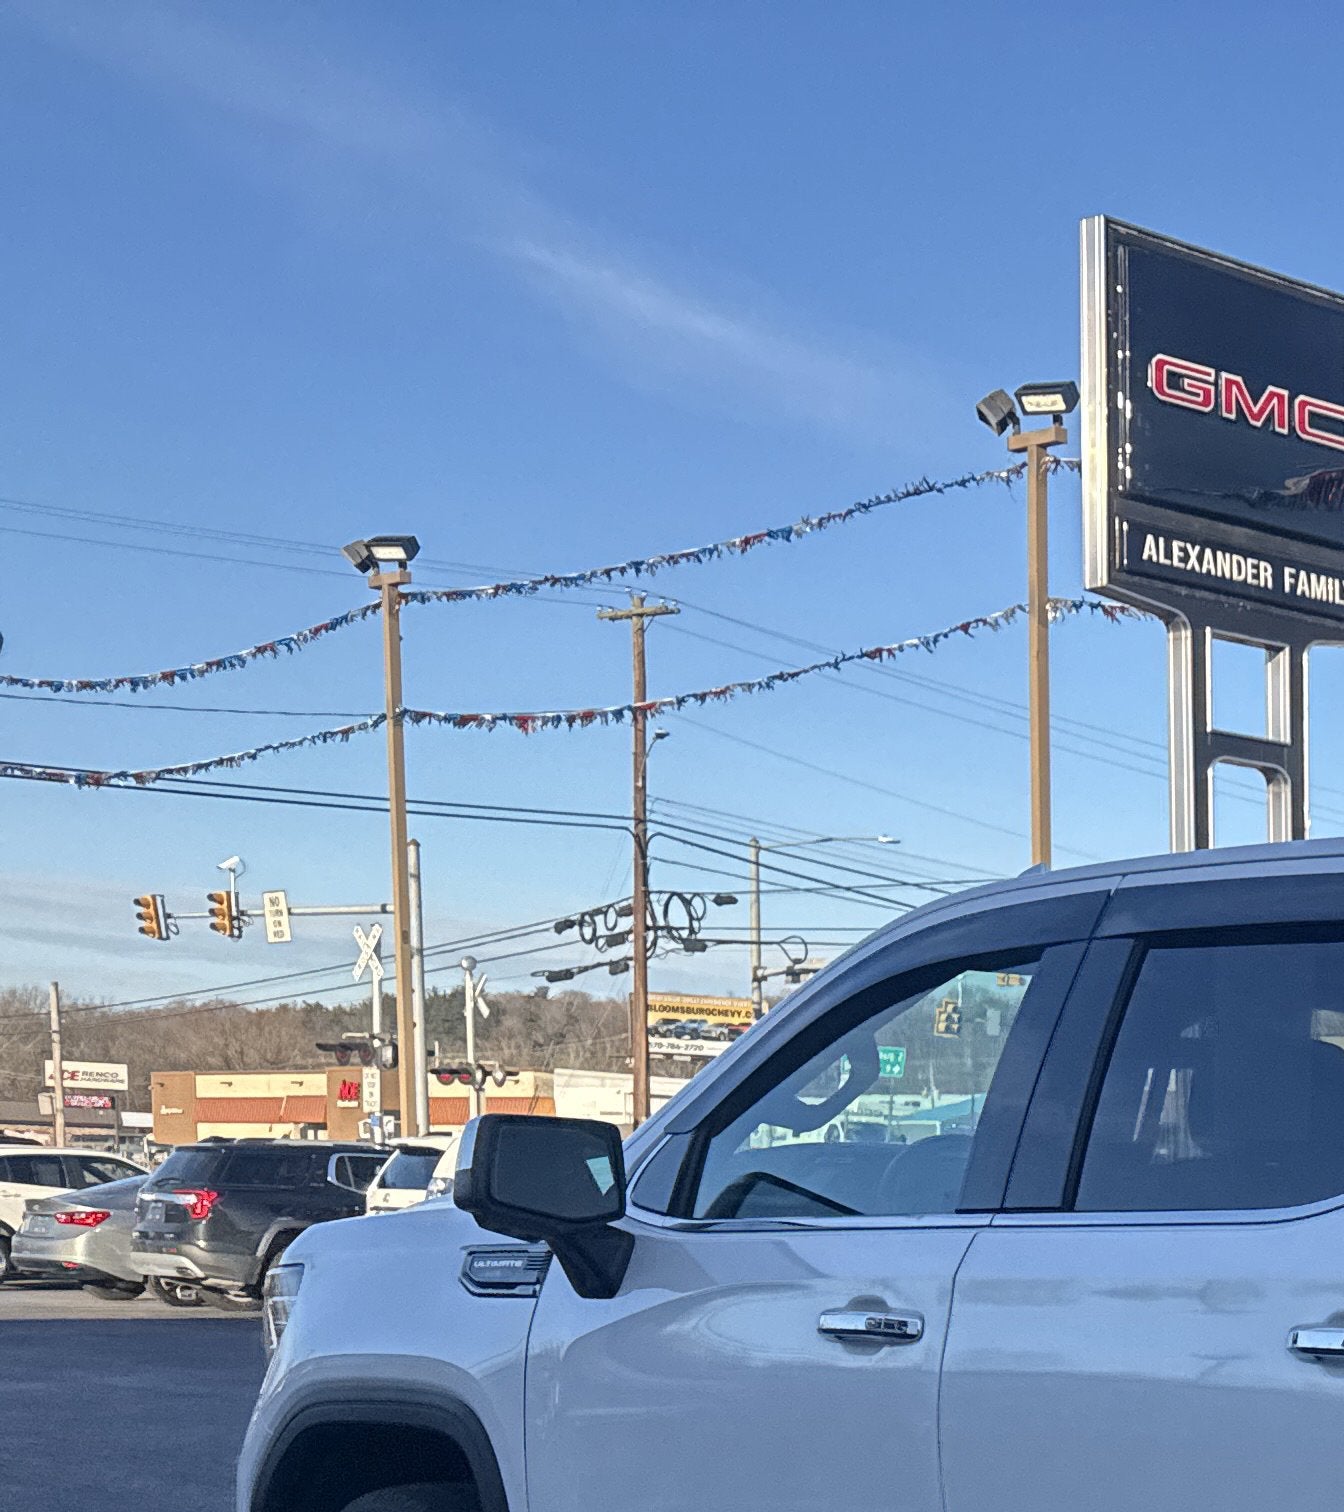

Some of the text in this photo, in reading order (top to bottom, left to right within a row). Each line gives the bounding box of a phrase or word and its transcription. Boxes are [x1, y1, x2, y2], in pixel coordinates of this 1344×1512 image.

[1142, 533, 1274, 590] ALEXANDER
[268, 895, 281, 907] NO
[473, 1259, 523, 1268] ULTIMATE
